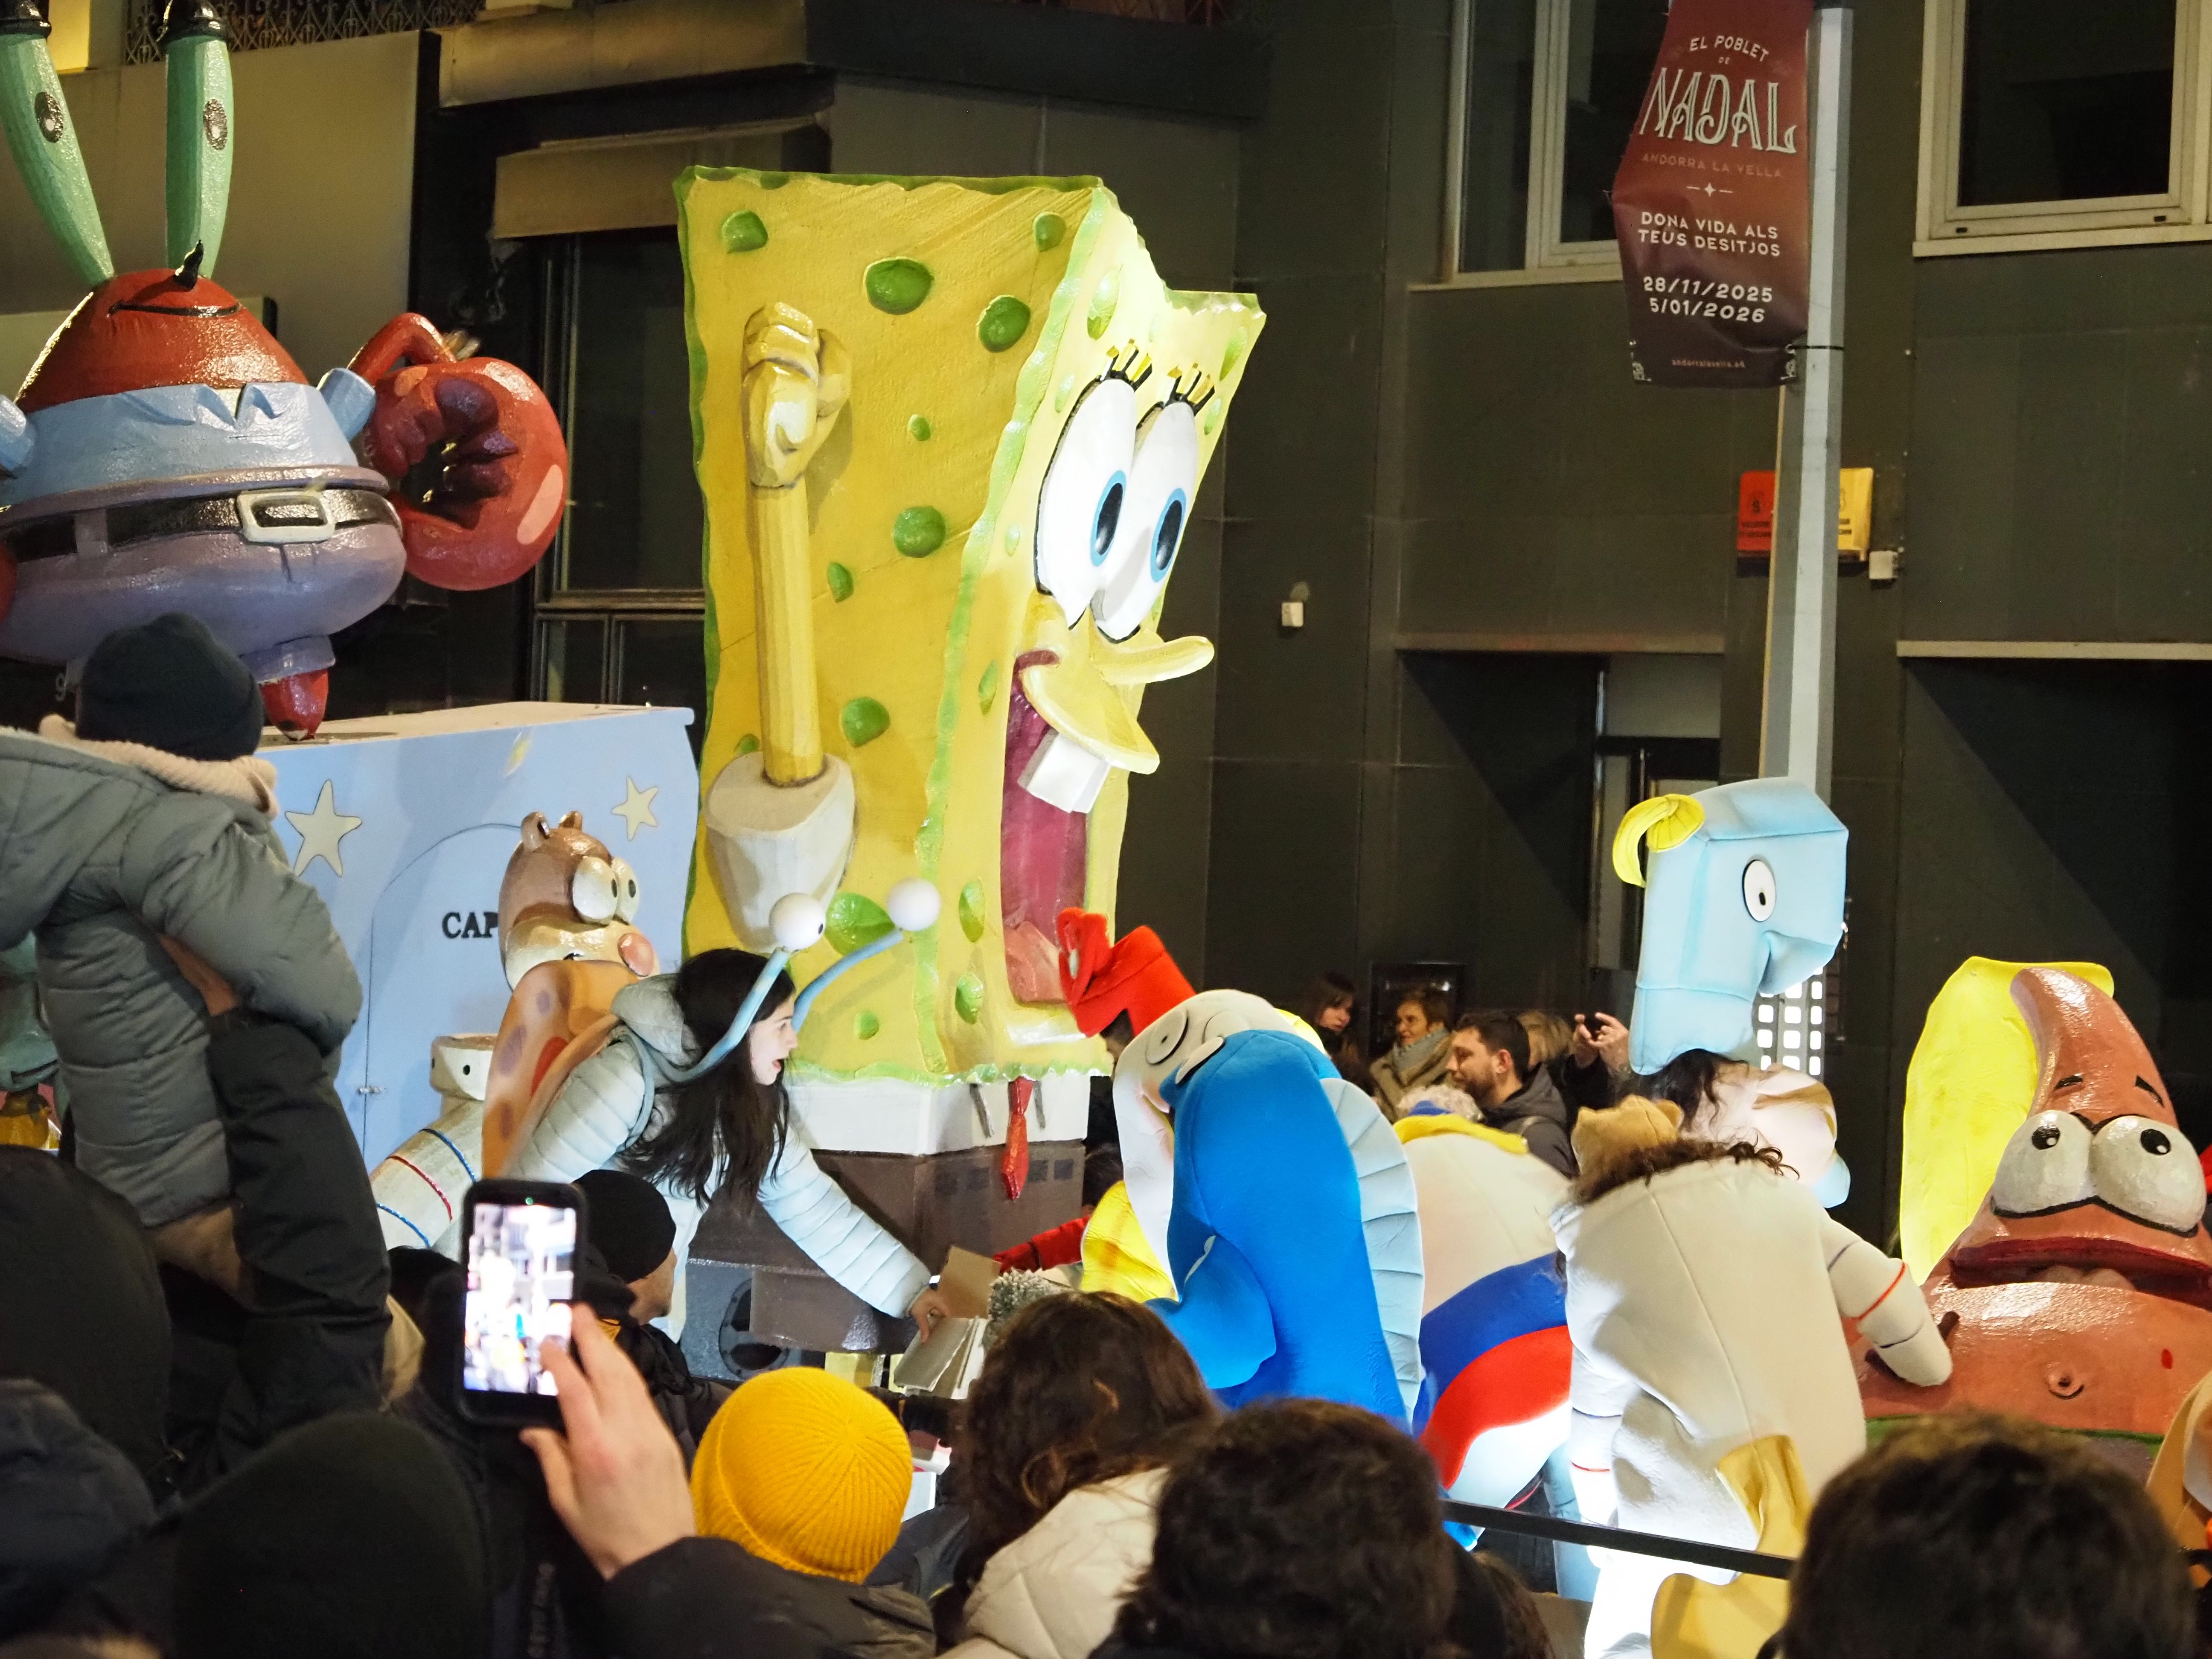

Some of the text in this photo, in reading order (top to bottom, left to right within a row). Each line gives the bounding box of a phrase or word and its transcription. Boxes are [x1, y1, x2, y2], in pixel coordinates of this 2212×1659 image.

[1689, 35, 1769, 62] EL POBLET
[1639, 67, 1797, 154] NADAL
[1642, 153, 1782, 178] ANDORRA LA VELLA
[1641, 212, 1778, 239] DONA VIDA ALS
[1638, 229, 1780, 256] TEUS DESITJOS
[1643, 276, 1773, 303] 28/11/2025
[1650, 297, 1765, 323] 5/01/2026
